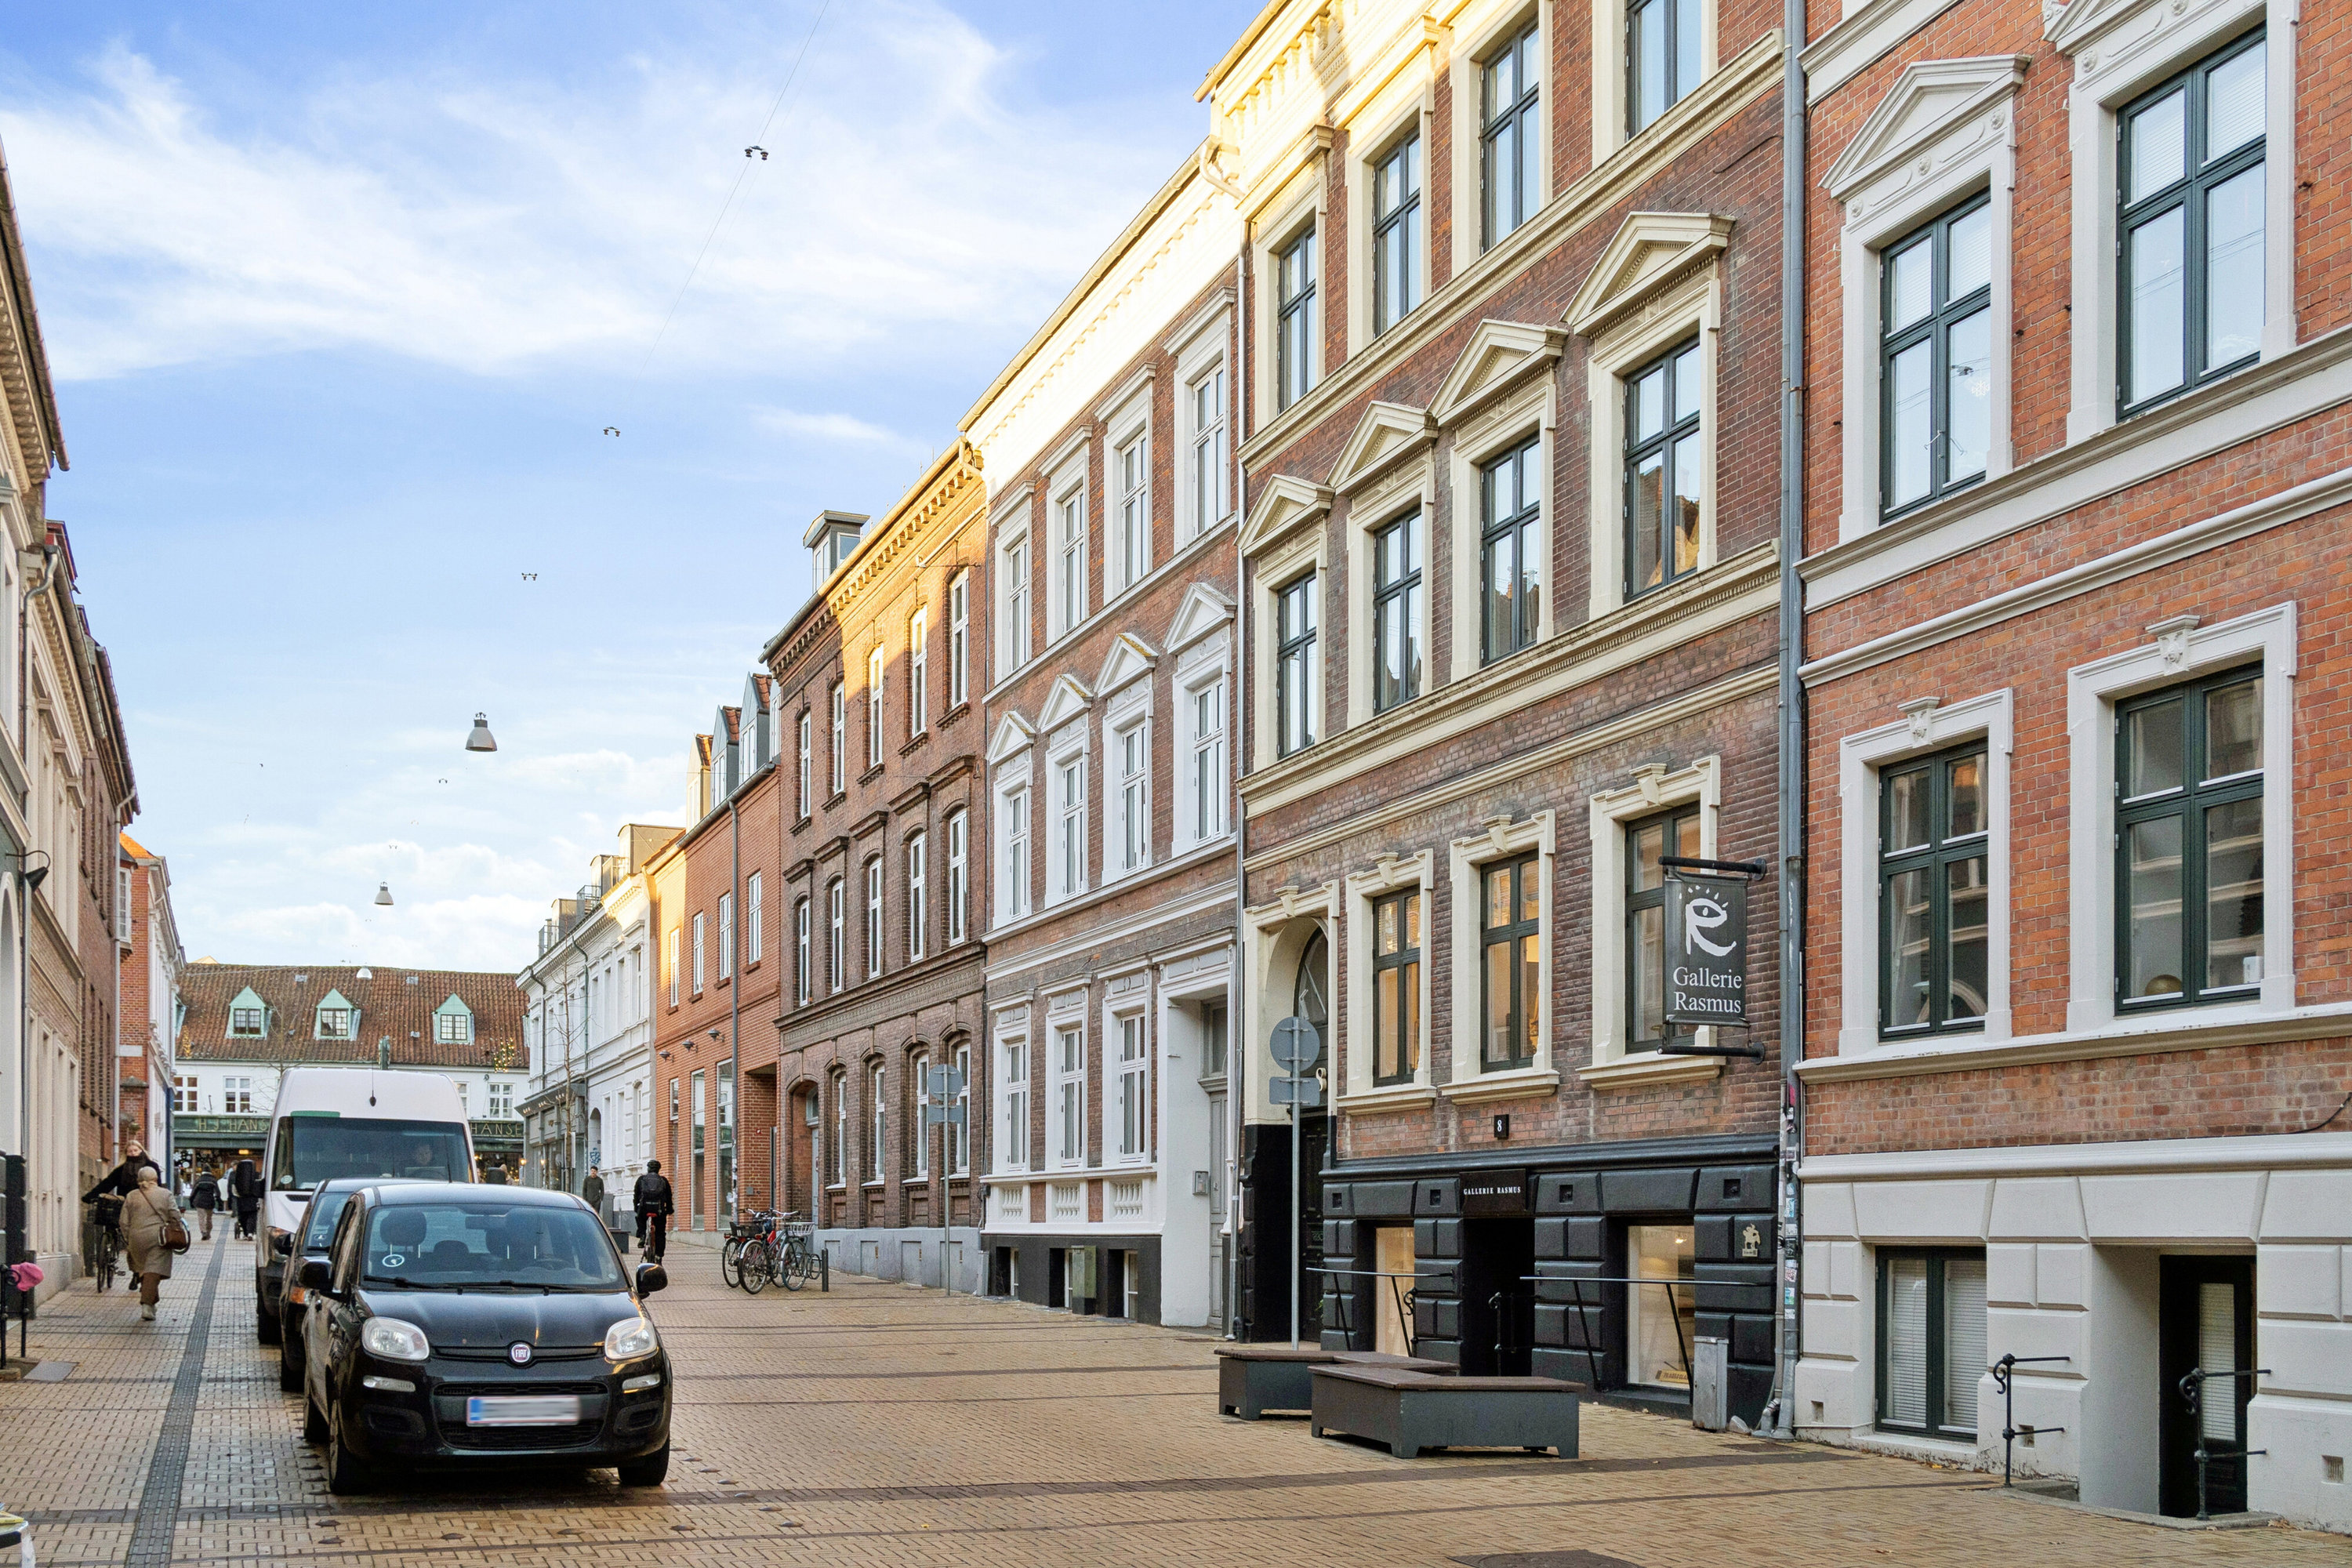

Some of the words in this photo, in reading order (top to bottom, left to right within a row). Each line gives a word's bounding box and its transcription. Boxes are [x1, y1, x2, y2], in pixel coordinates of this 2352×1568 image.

[1673, 966, 1742, 989] Gallerie
[1674, 991, 1741, 1014] Rasmus
[198, 1118, 207, 1131] H
[1497, 1119, 1502, 1132] 8
[1463, 1187, 1494, 1196] GALLERIE
[515, 1348, 527, 1358] FIAT
